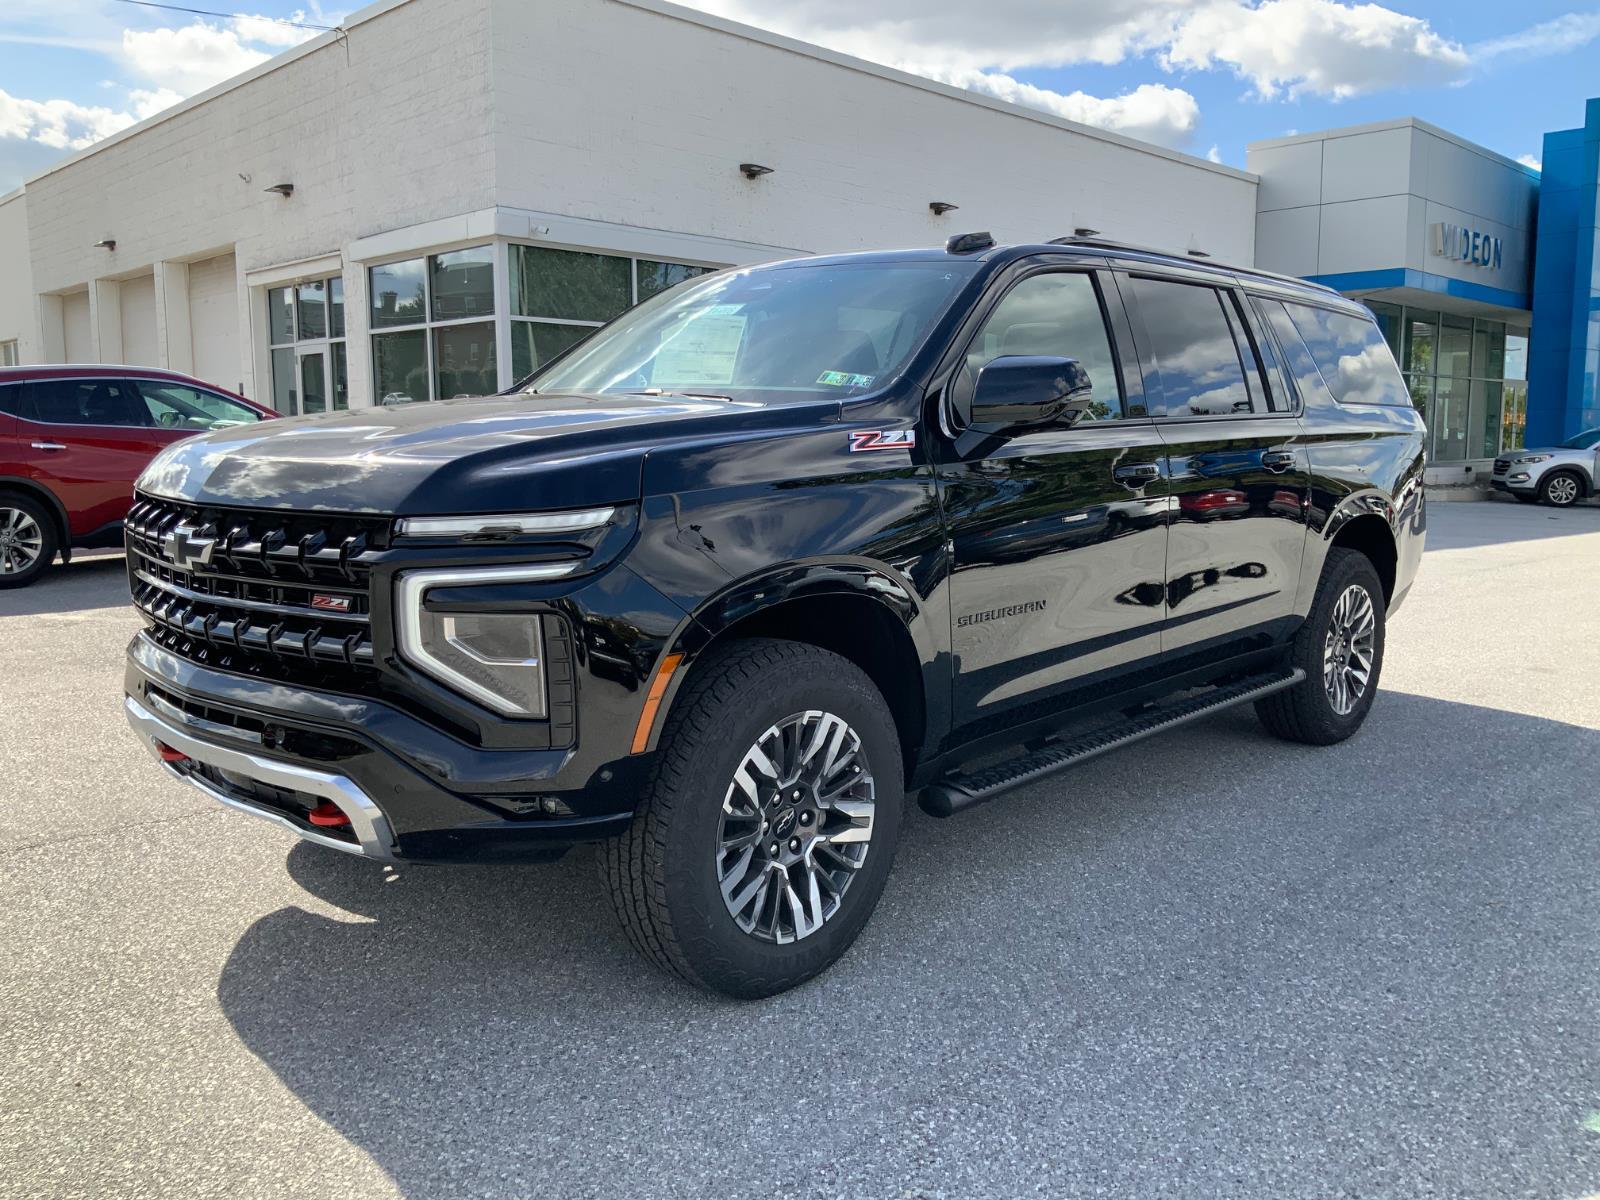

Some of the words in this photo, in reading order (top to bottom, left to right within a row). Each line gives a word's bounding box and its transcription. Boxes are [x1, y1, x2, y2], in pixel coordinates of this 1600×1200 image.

[849, 430, 916, 452] Z71
[311, 595, 351, 611] Z71
[957, 599, 1047, 628] SUBURBAN
